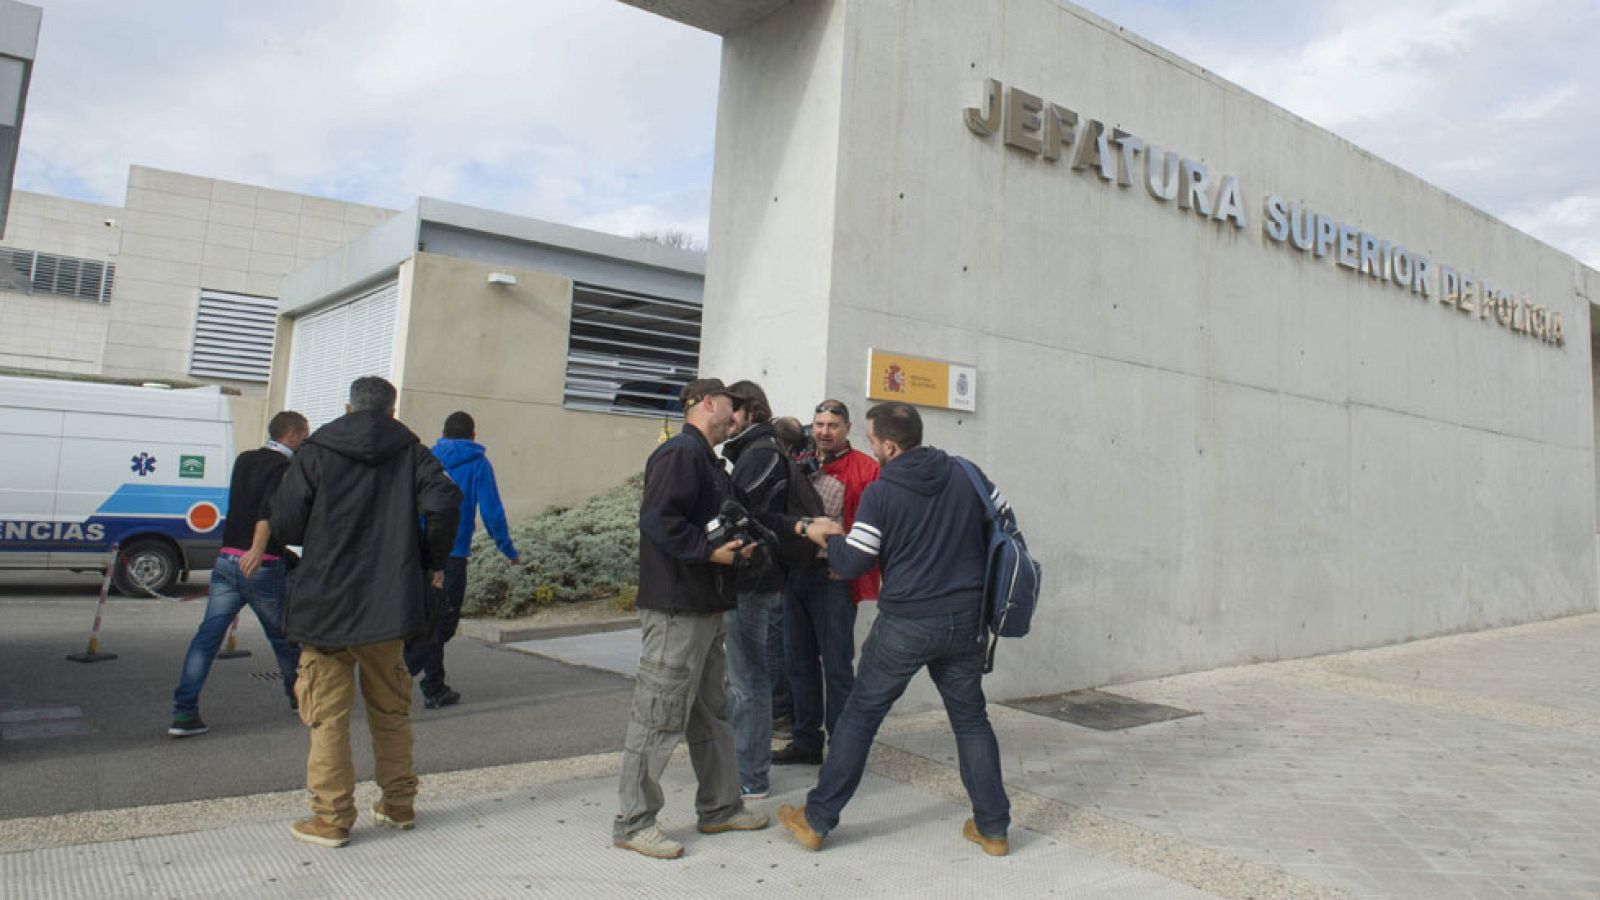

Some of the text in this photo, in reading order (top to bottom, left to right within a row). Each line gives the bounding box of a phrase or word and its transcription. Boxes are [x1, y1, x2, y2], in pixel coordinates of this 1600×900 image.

[963, 78, 1247, 229] JEFATURA
[1262, 194, 1432, 298] SUPERIOR
[1439, 263, 1475, 313] DE
[0, 521, 105, 541] NCIAS
